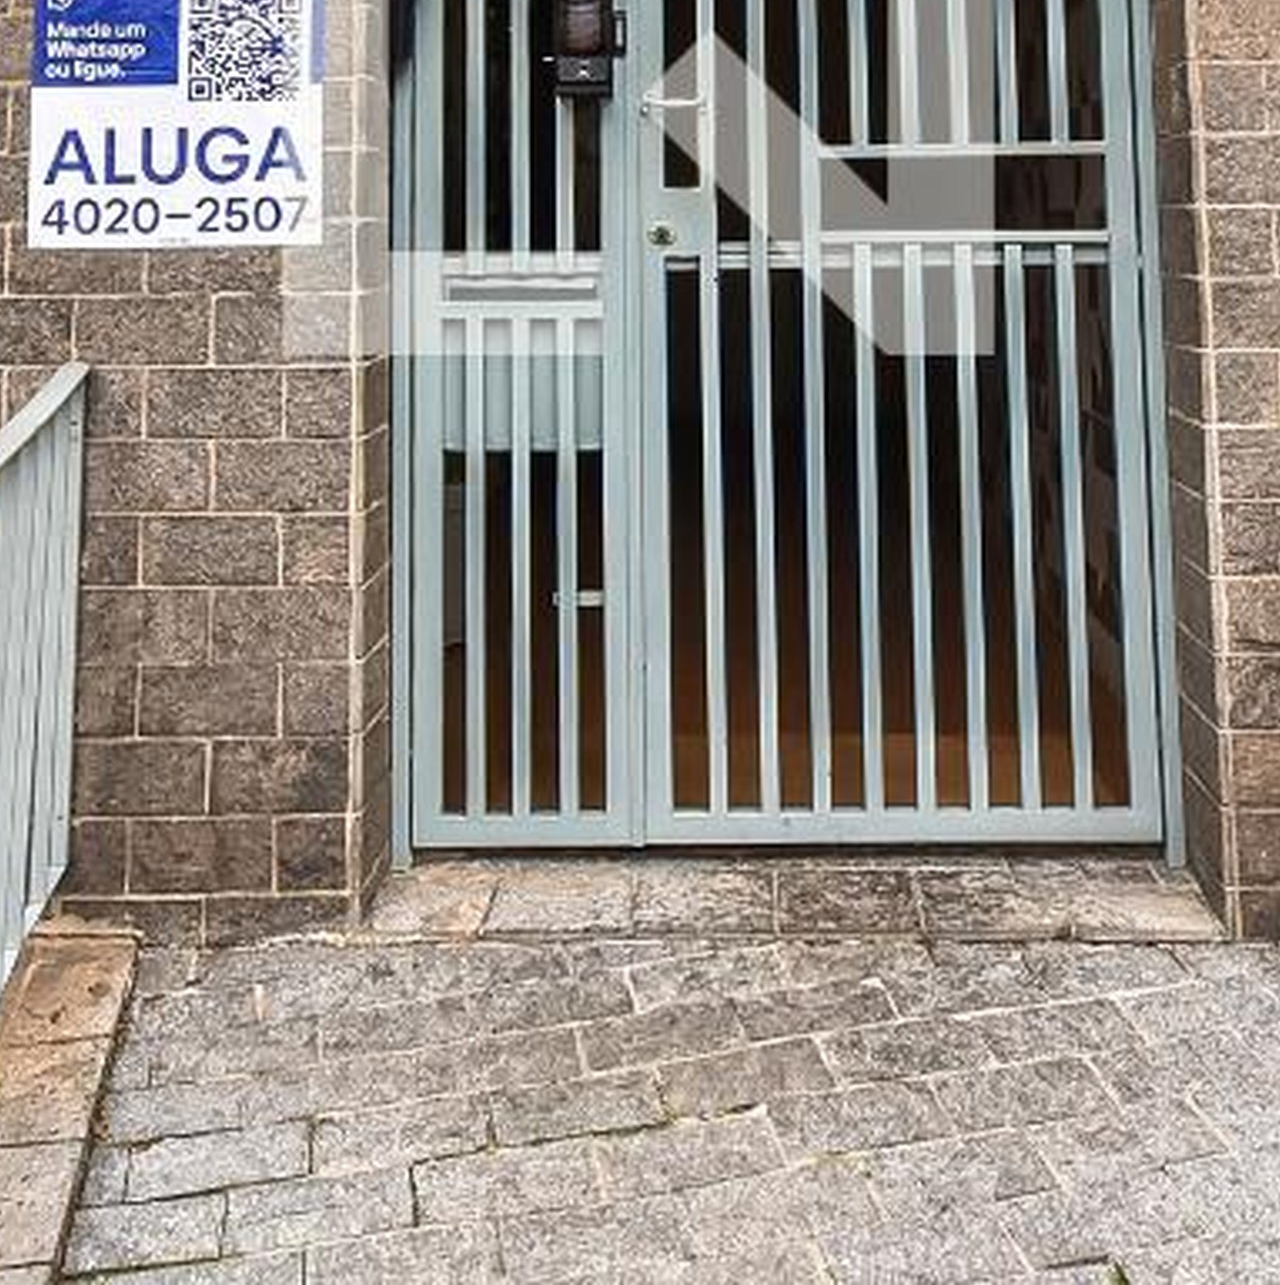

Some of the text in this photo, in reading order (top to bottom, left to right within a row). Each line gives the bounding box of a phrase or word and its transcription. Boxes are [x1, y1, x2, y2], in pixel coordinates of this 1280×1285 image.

[114, 24, 146, 38] um
[46, 41, 146, 60] Whatsapp
[44, 62, 69, 79] ou
[43, 126, 308, 185] ALUGA
[41, 196, 309, 236] 4020-2507
